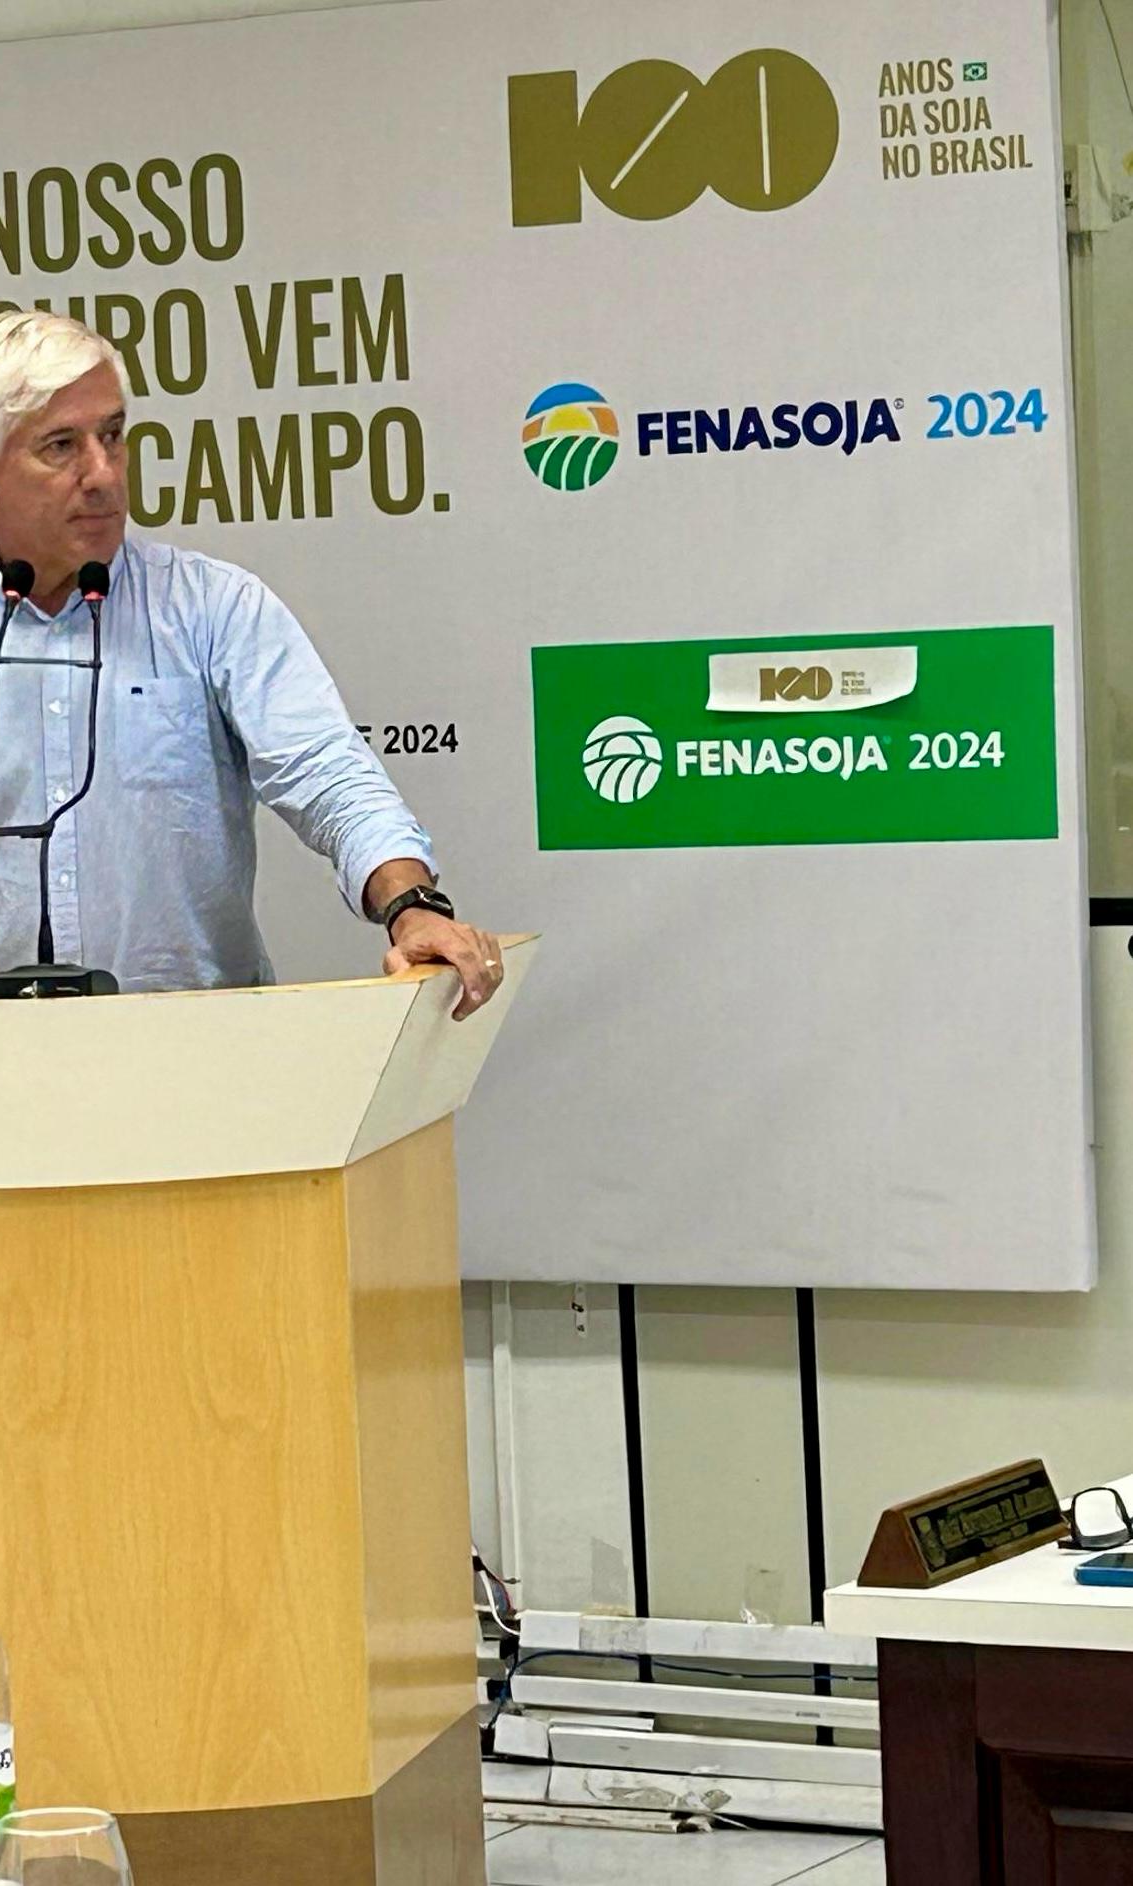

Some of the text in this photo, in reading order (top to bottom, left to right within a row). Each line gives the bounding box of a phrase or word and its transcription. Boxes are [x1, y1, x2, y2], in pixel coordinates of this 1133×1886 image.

[879, 58, 954, 98] ANOS
[880, 96, 992, 138] DA SOJA
[882, 134, 1033, 180] NO BRASIL
[234, 273, 410, 389] VEM
[926, 388, 1049, 439] 2024
[127, 407, 451, 528] CAMPO.
[383, 723, 459, 755] 2024
[676, 731, 1005, 780] FENASOJA 2024
